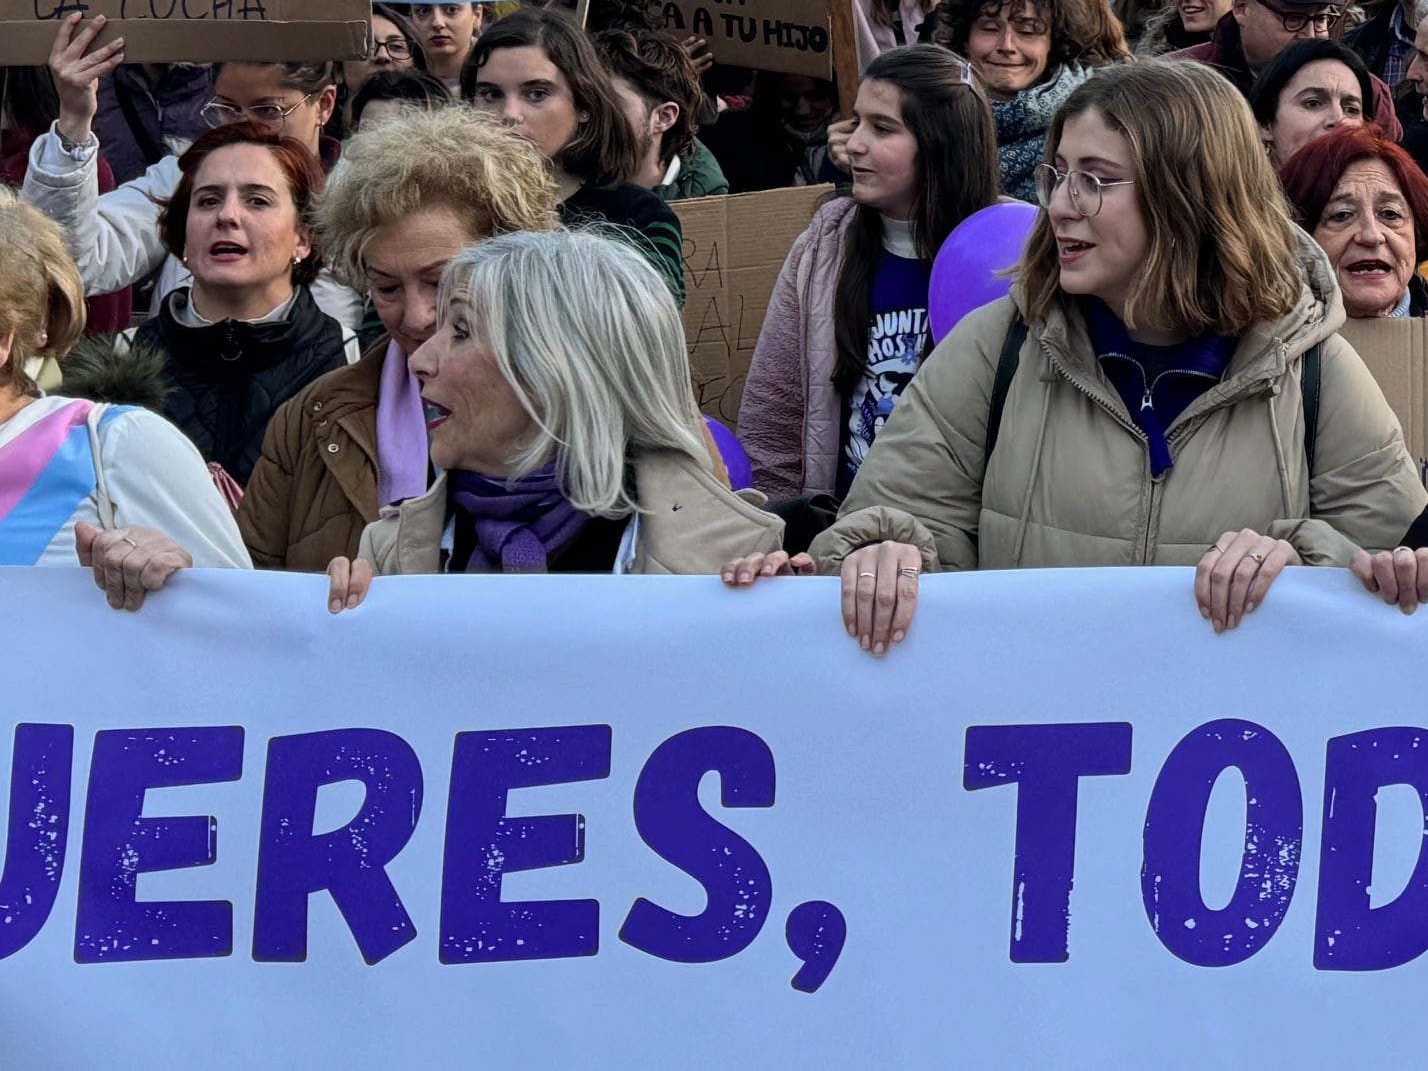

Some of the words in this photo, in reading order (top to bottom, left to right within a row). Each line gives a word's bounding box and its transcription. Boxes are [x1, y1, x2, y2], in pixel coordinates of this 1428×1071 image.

[693, 7, 713, 36] A
[719, 13, 756, 43] TU
[763, 19, 828, 53] HIJO
